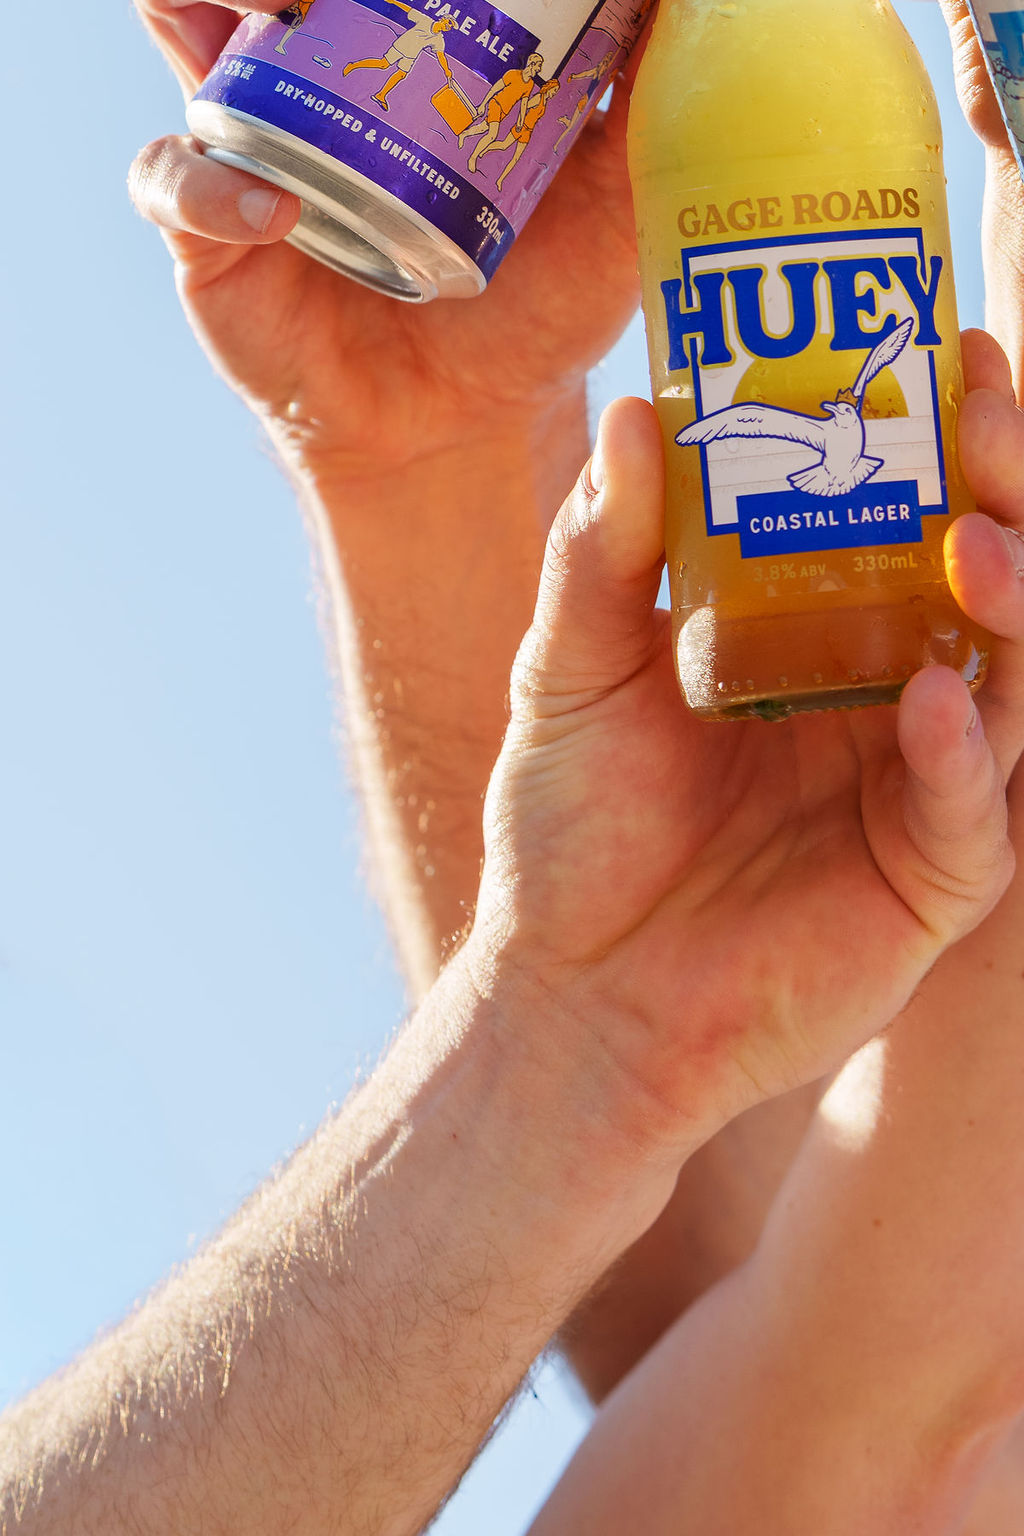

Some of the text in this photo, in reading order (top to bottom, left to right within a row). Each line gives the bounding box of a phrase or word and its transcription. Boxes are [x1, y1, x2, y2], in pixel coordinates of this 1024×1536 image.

[475, 32, 514, 63] ALE
[274, 80, 460, 200] DRY-HOPPED & UNFILTERED
[476, 206, 504, 245] 330mL
[677, 187, 920, 238] GAGE ROADS
[660, 255, 943, 371] HUEY
[750, 504, 911, 534] COASTAL LAGER
[753, 563, 827, 582] 3.8% ABV
[853, 552, 918, 572] 330mL
